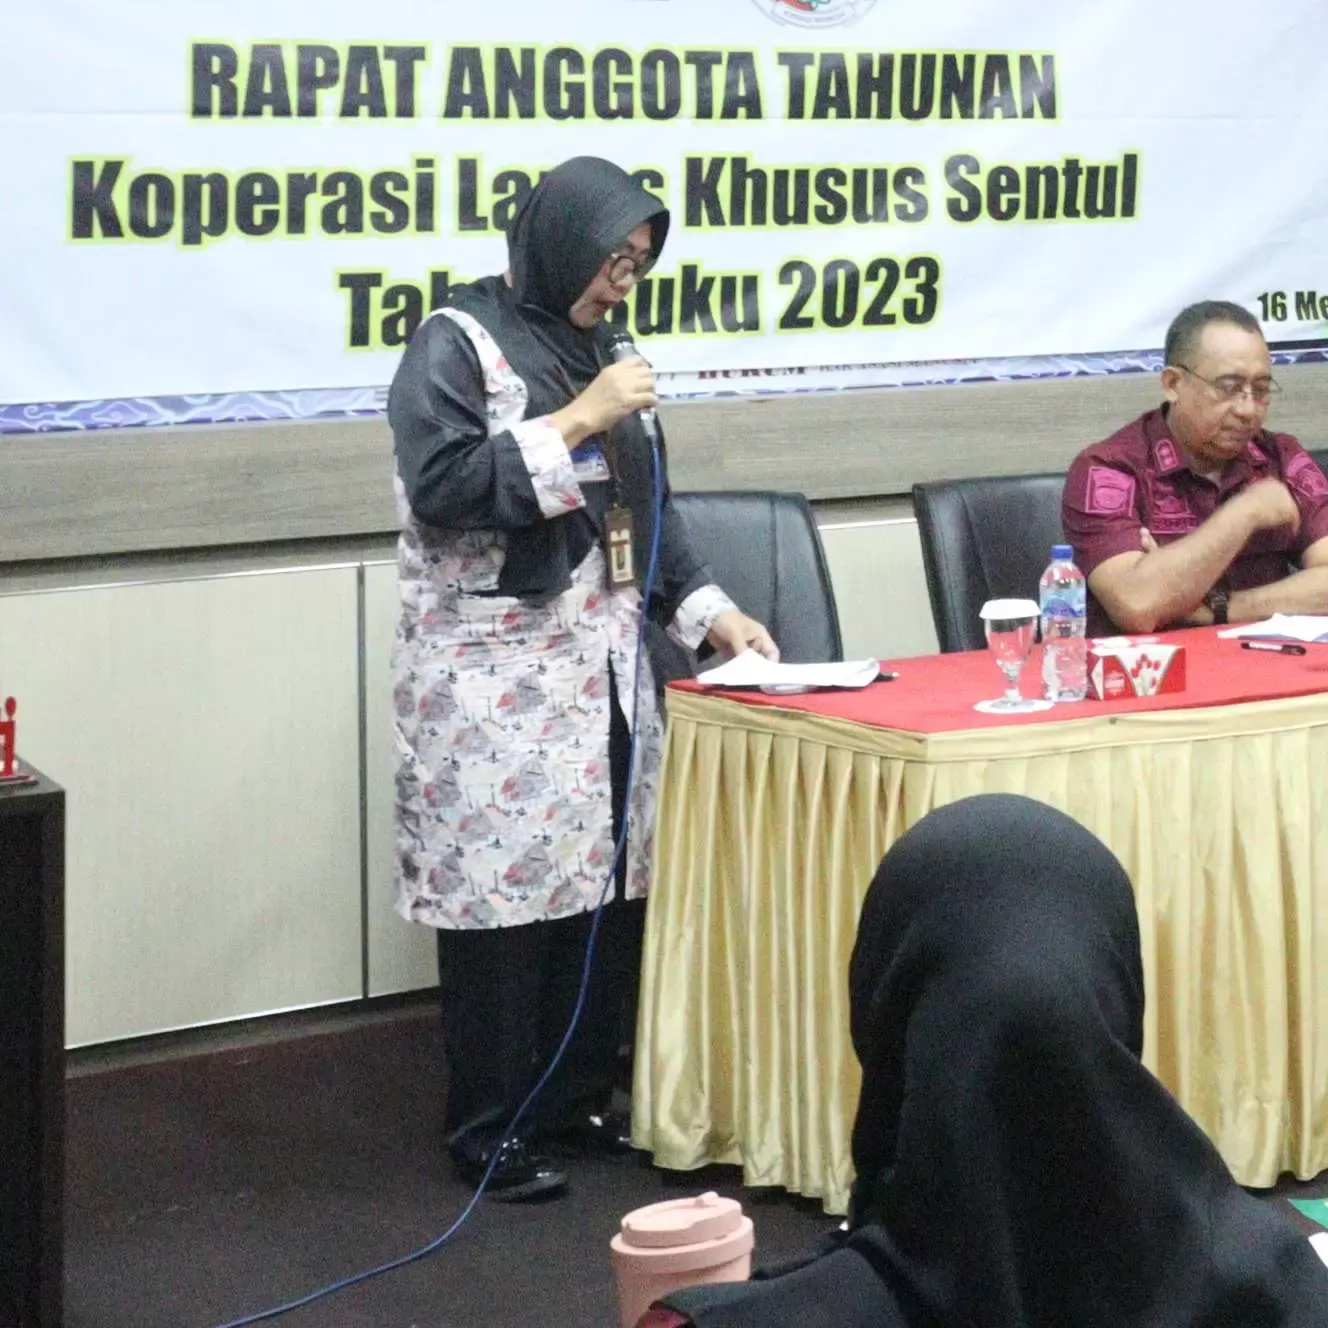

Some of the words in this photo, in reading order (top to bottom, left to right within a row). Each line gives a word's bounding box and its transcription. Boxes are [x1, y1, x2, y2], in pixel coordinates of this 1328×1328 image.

[190, 43, 426, 119] RAPAT
[443, 46, 764, 121] ANGGOTA
[778, 51, 1058, 121] TAHUNAN
[71, 158, 435, 246] Koperasi
[457, 157, 666, 232] Las
[684, 156, 929, 227] Khusus
[944, 153, 1138, 223] Sentul
[604, 263, 760, 336] uku
[778, 256, 941, 331] 2023
[1257, 291, 1288, 322] 16
